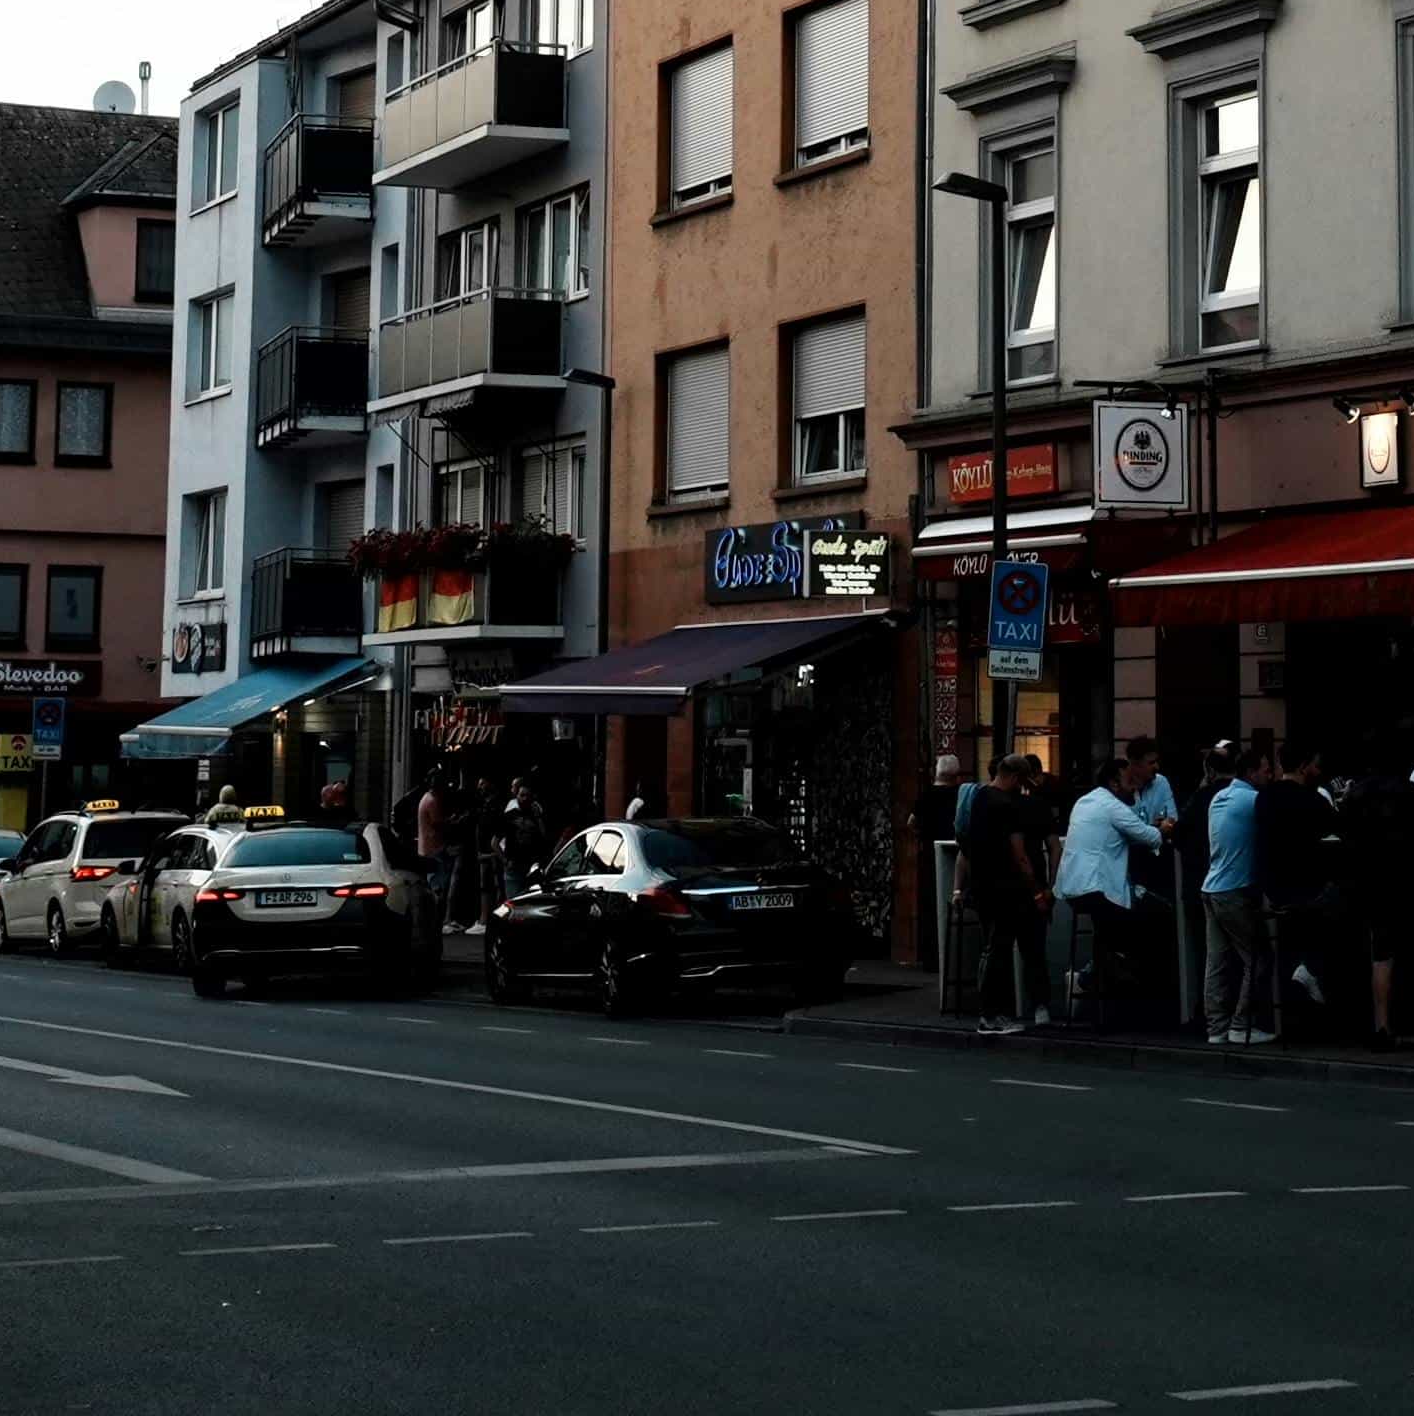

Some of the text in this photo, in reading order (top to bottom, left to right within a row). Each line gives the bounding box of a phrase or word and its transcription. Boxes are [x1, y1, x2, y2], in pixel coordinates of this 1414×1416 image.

[1123, 451, 1163, 463] BINDING
[995, 620, 1037, 641] TAXI
[250, 807, 277, 817] TAXI
[765, 894, 793, 905] 2009
